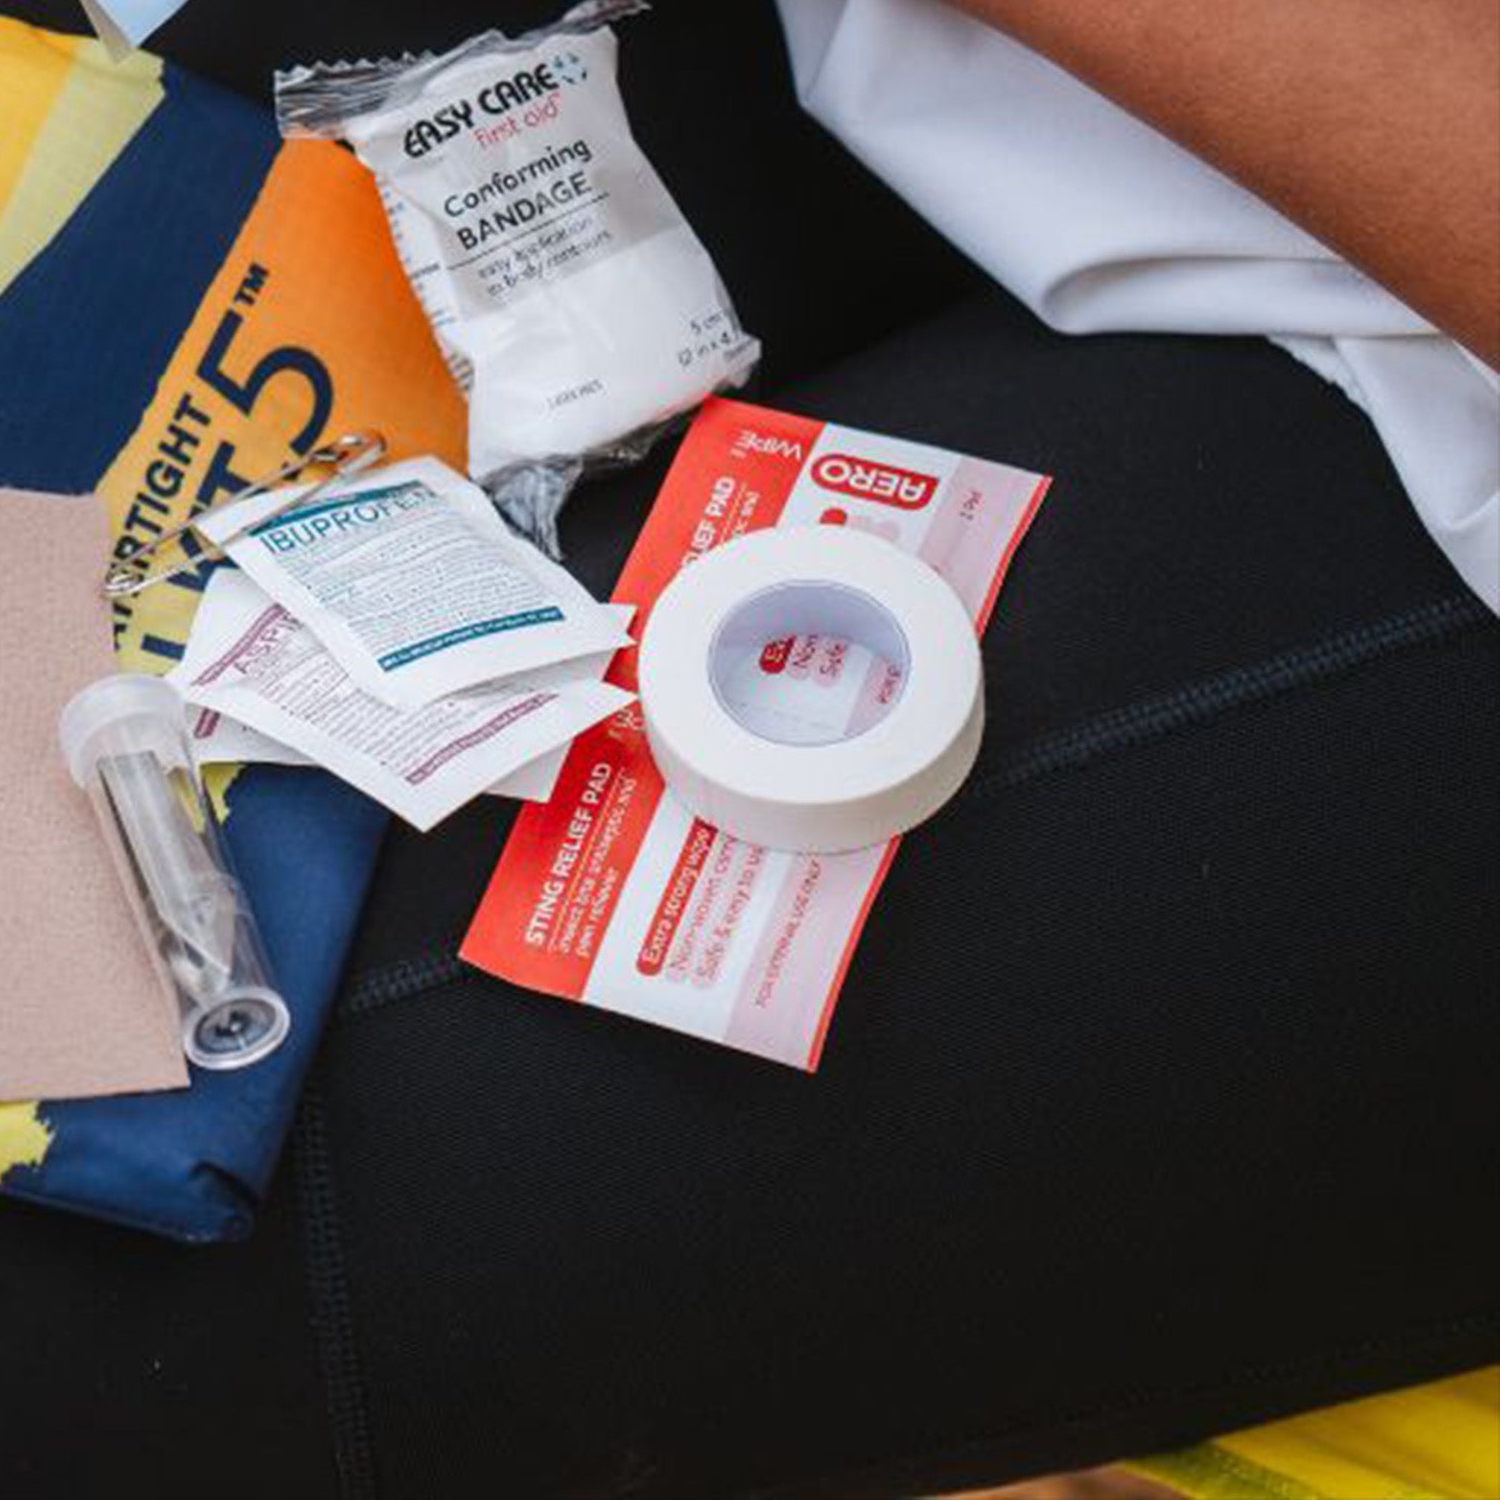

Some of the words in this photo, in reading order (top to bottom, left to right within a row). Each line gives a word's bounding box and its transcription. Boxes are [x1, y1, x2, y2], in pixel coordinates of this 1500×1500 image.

[403, 99, 475, 159] EASY
[477, 62, 561, 115] CARE
[473, 118, 520, 149] first
[444, 139, 593, 217] Conforming
[456, 171, 594, 251] BANDAGE
[738, 429, 802, 461] WIPE
[705, 475, 736, 517] PAD
[819, 458, 928, 503] AERO
[259, 485, 437, 554] IBUPROFEN
[525, 879, 565, 946] STING
[552, 807, 593, 880] RELIEF
[582, 762, 612, 805] PAD
[643, 918, 673, 963] Extra
[664, 869, 697, 920] strong
[696, 942, 725, 982] Safe
